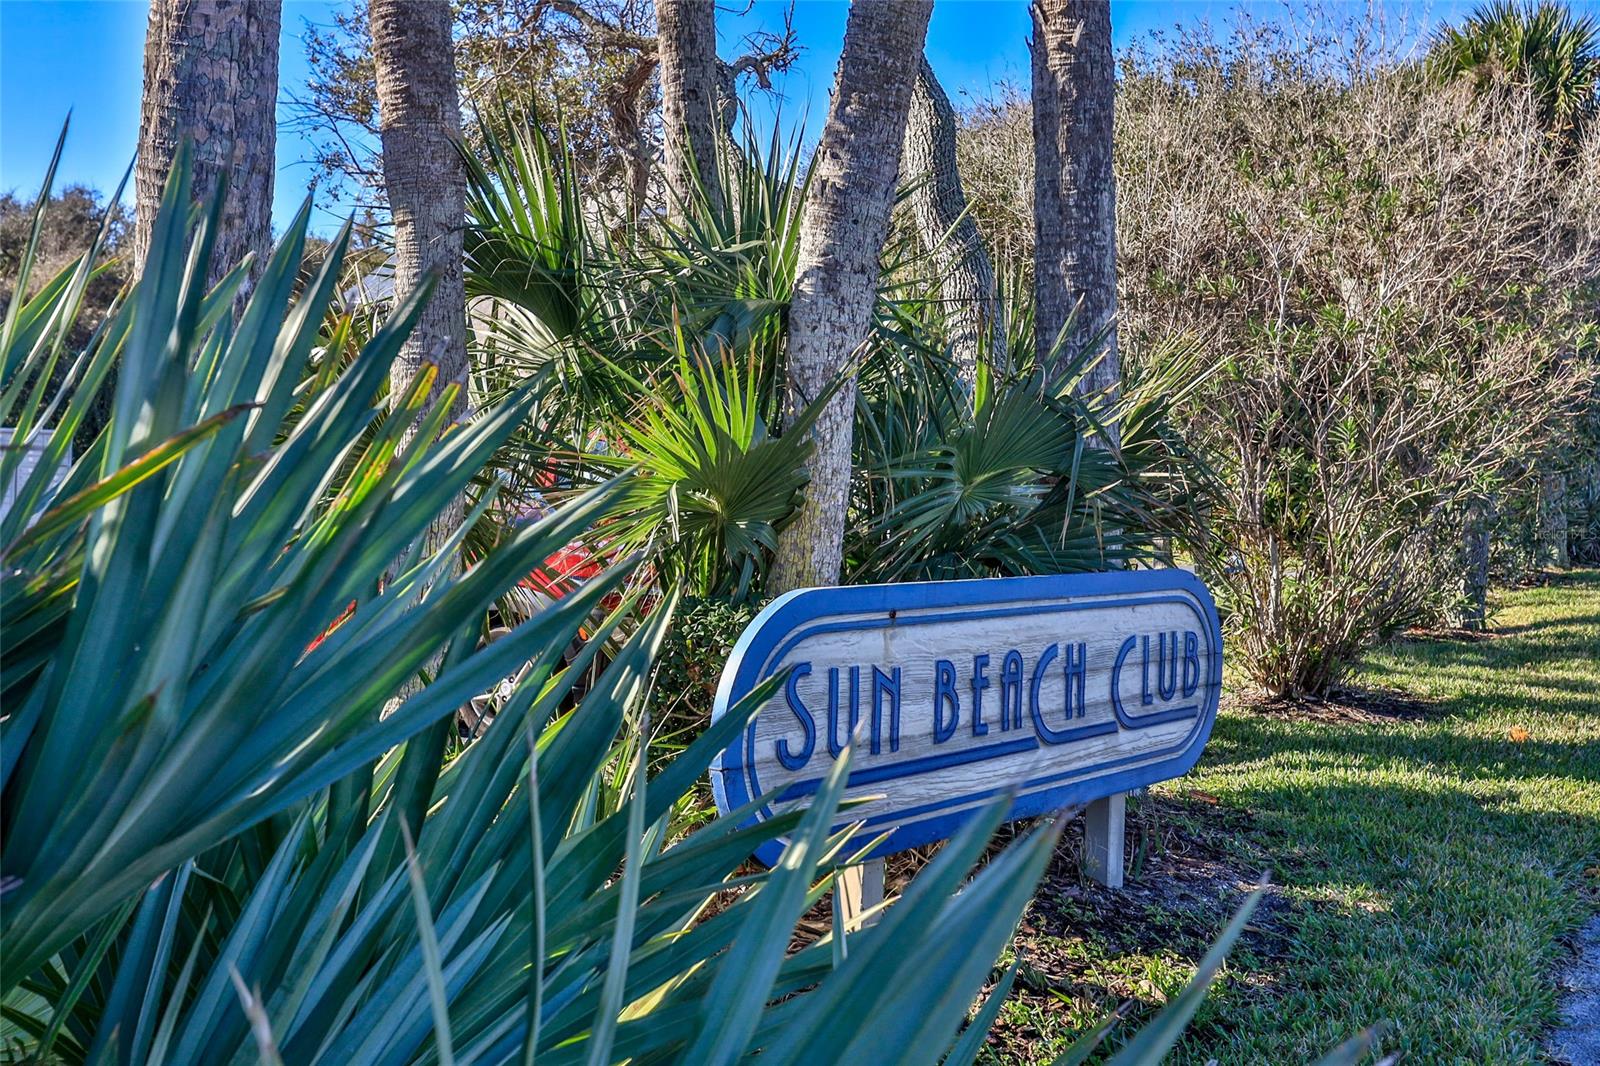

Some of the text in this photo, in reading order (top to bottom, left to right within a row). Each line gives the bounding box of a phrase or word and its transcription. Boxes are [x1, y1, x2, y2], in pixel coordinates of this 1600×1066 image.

[776, 631, 1200, 771] SUN BEACH CLUB
